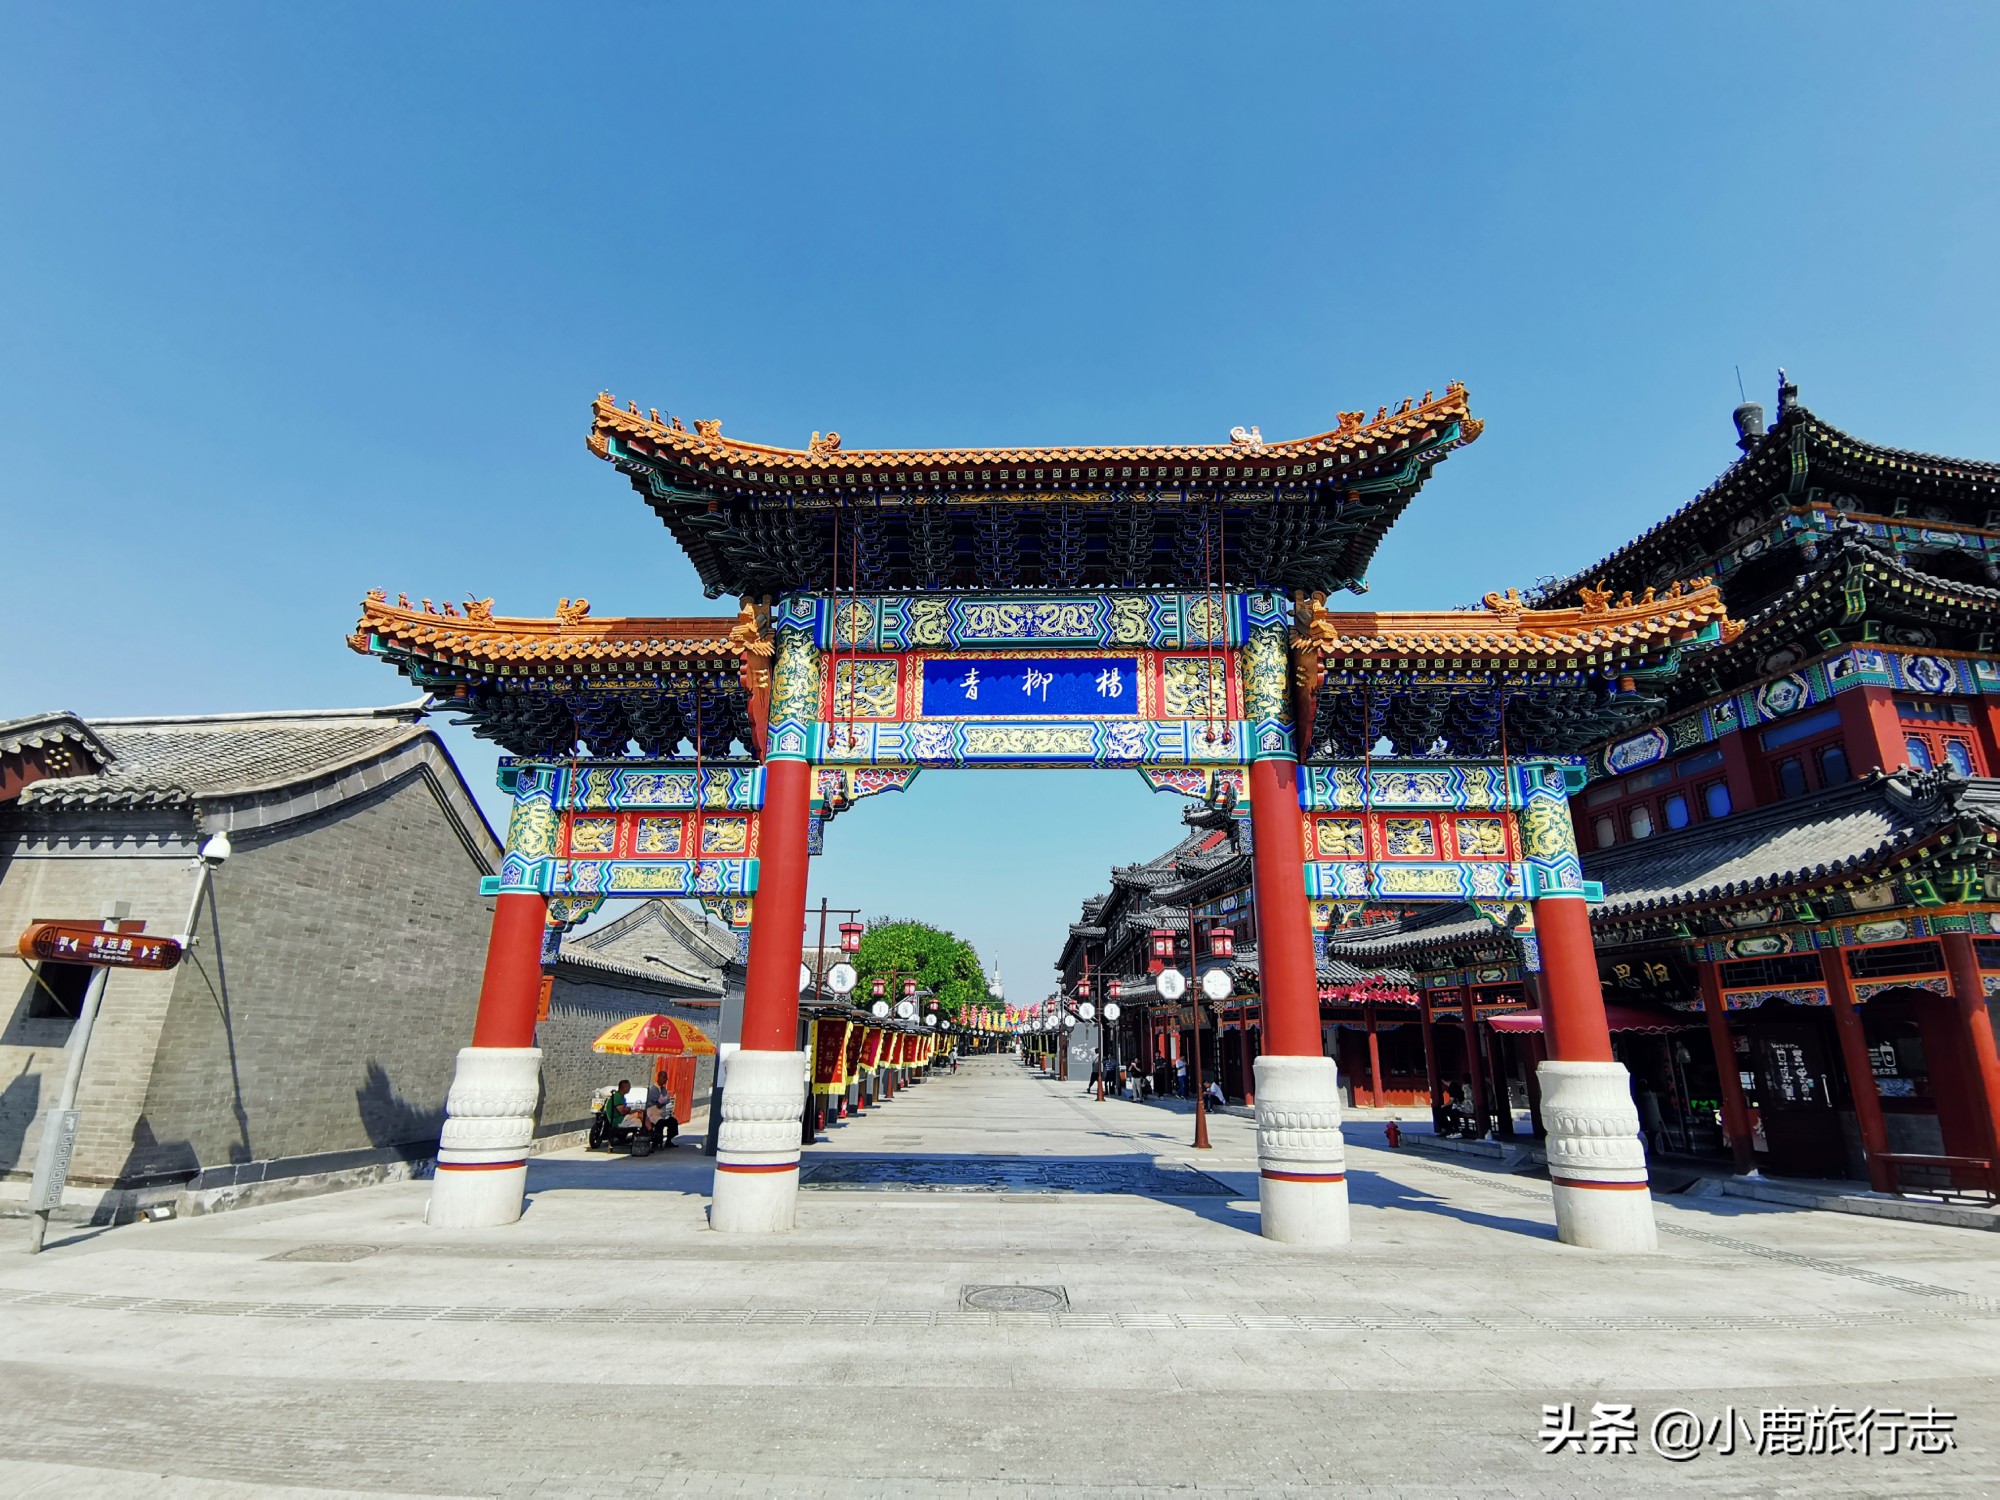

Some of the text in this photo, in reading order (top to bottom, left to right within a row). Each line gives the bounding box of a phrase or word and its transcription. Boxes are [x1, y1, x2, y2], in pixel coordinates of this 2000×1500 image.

[59, 936, 70, 946] 南
[92, 935, 133, 951] 青远路
[151, 945, 161, 955] 北
